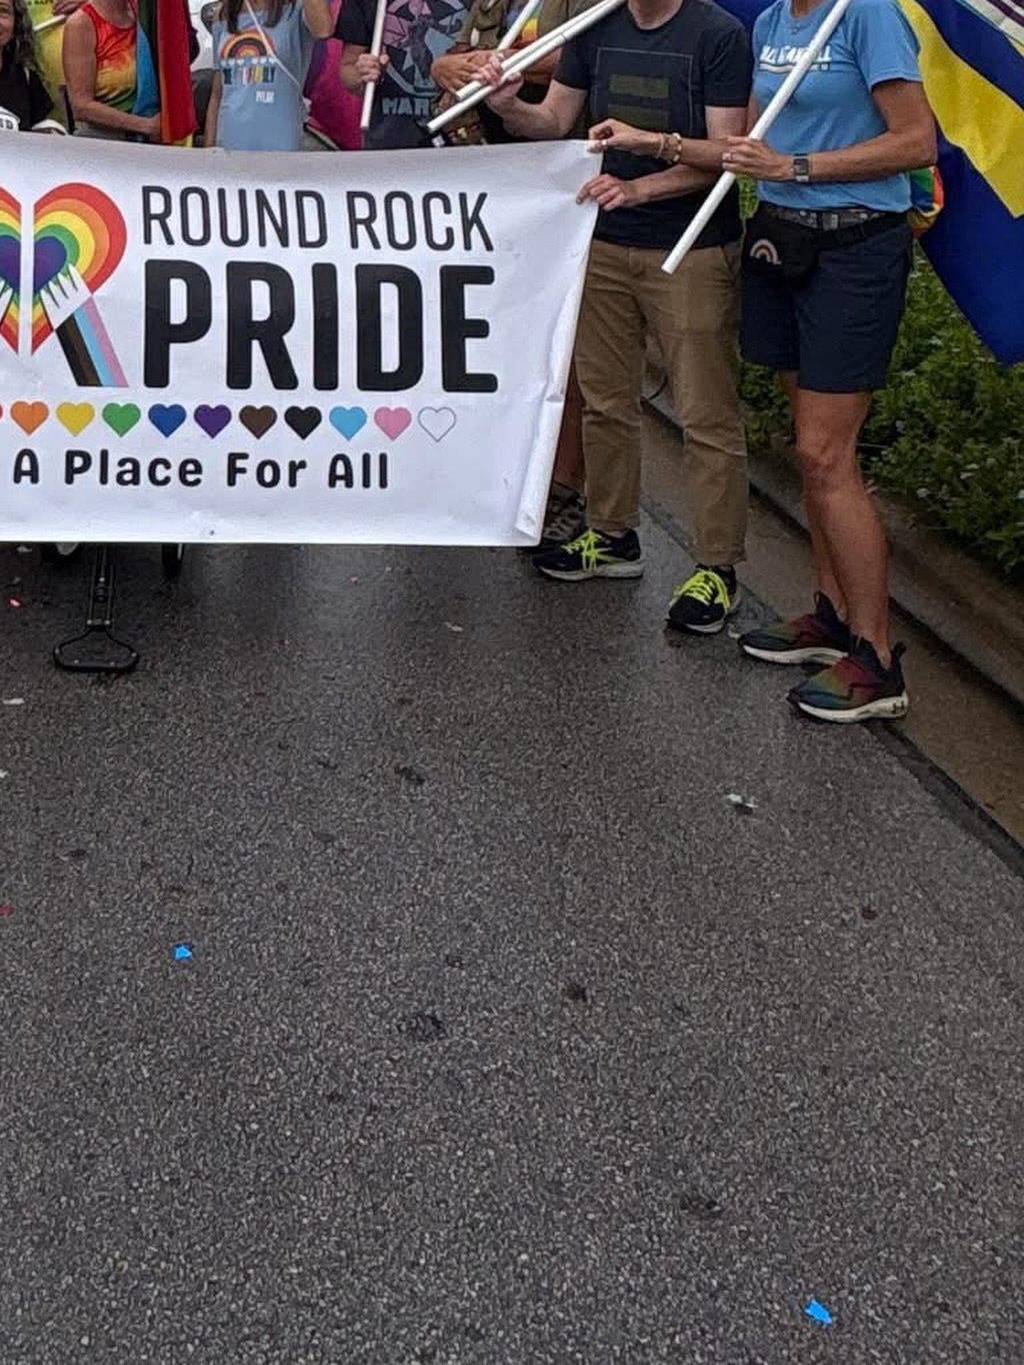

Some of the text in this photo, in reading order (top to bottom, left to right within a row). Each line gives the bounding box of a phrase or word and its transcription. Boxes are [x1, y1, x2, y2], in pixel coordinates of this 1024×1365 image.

[142, 185, 494, 252] ROUND ROCK
[143, 259, 499, 393] PRIDE
[13, 448, 388, 490] A Place For All
